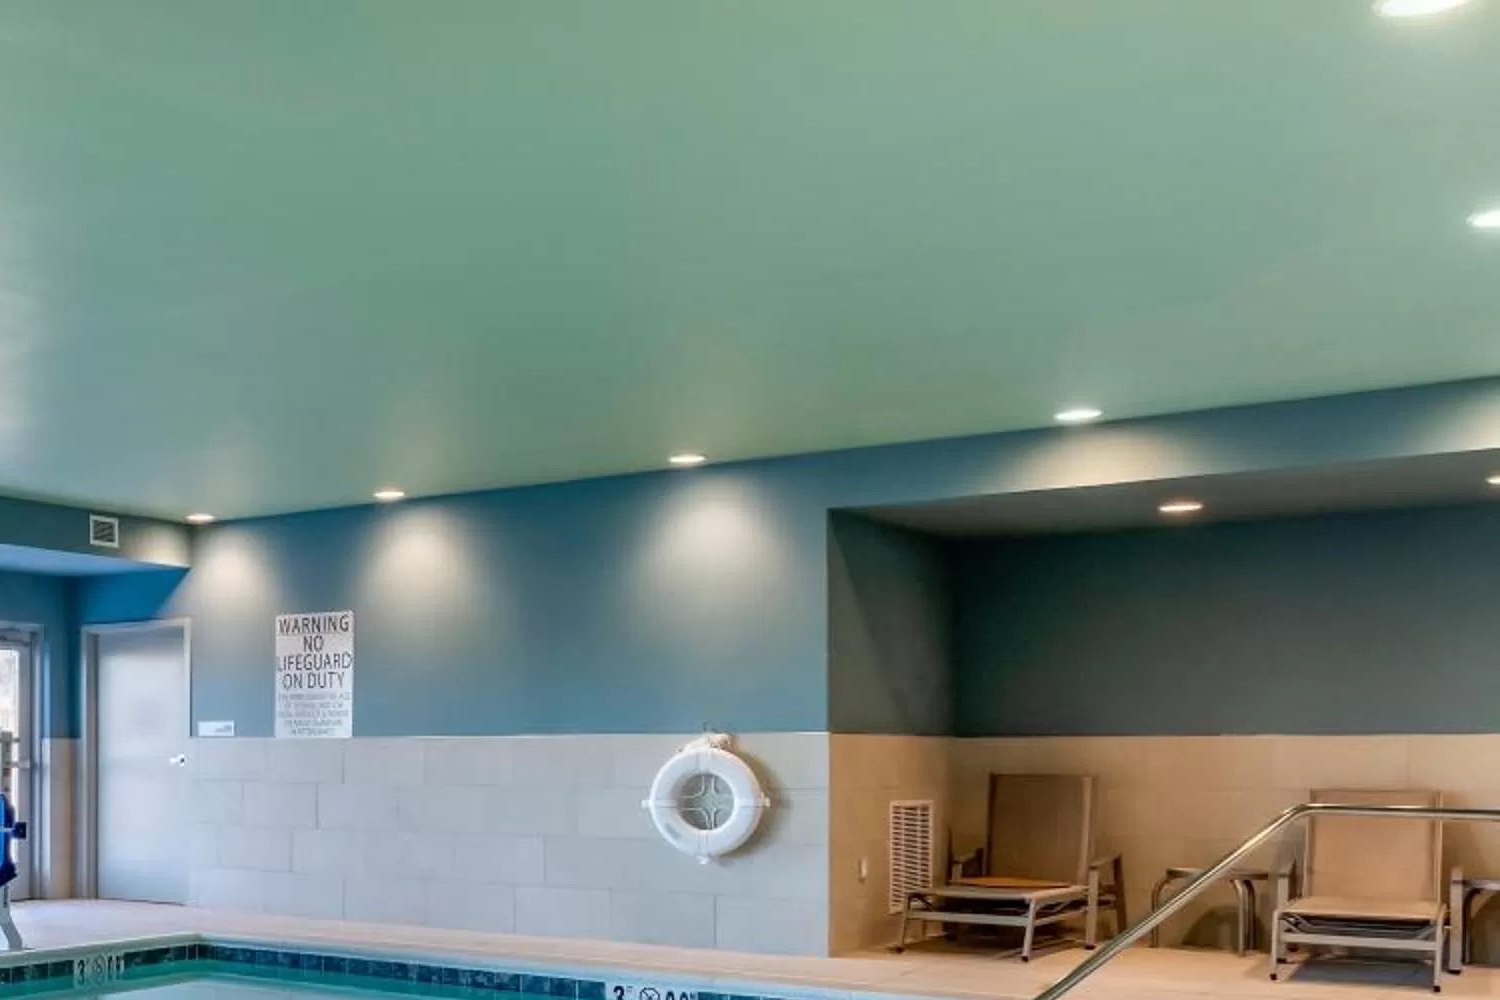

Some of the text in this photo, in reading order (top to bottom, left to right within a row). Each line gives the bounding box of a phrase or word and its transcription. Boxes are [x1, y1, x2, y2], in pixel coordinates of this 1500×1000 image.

[278, 615, 349, 634] WARNING
[303, 635, 324, 652] NO
[277, 652, 353, 672] LIFEGUARD
[282, 671, 345, 690] ON DUTY
